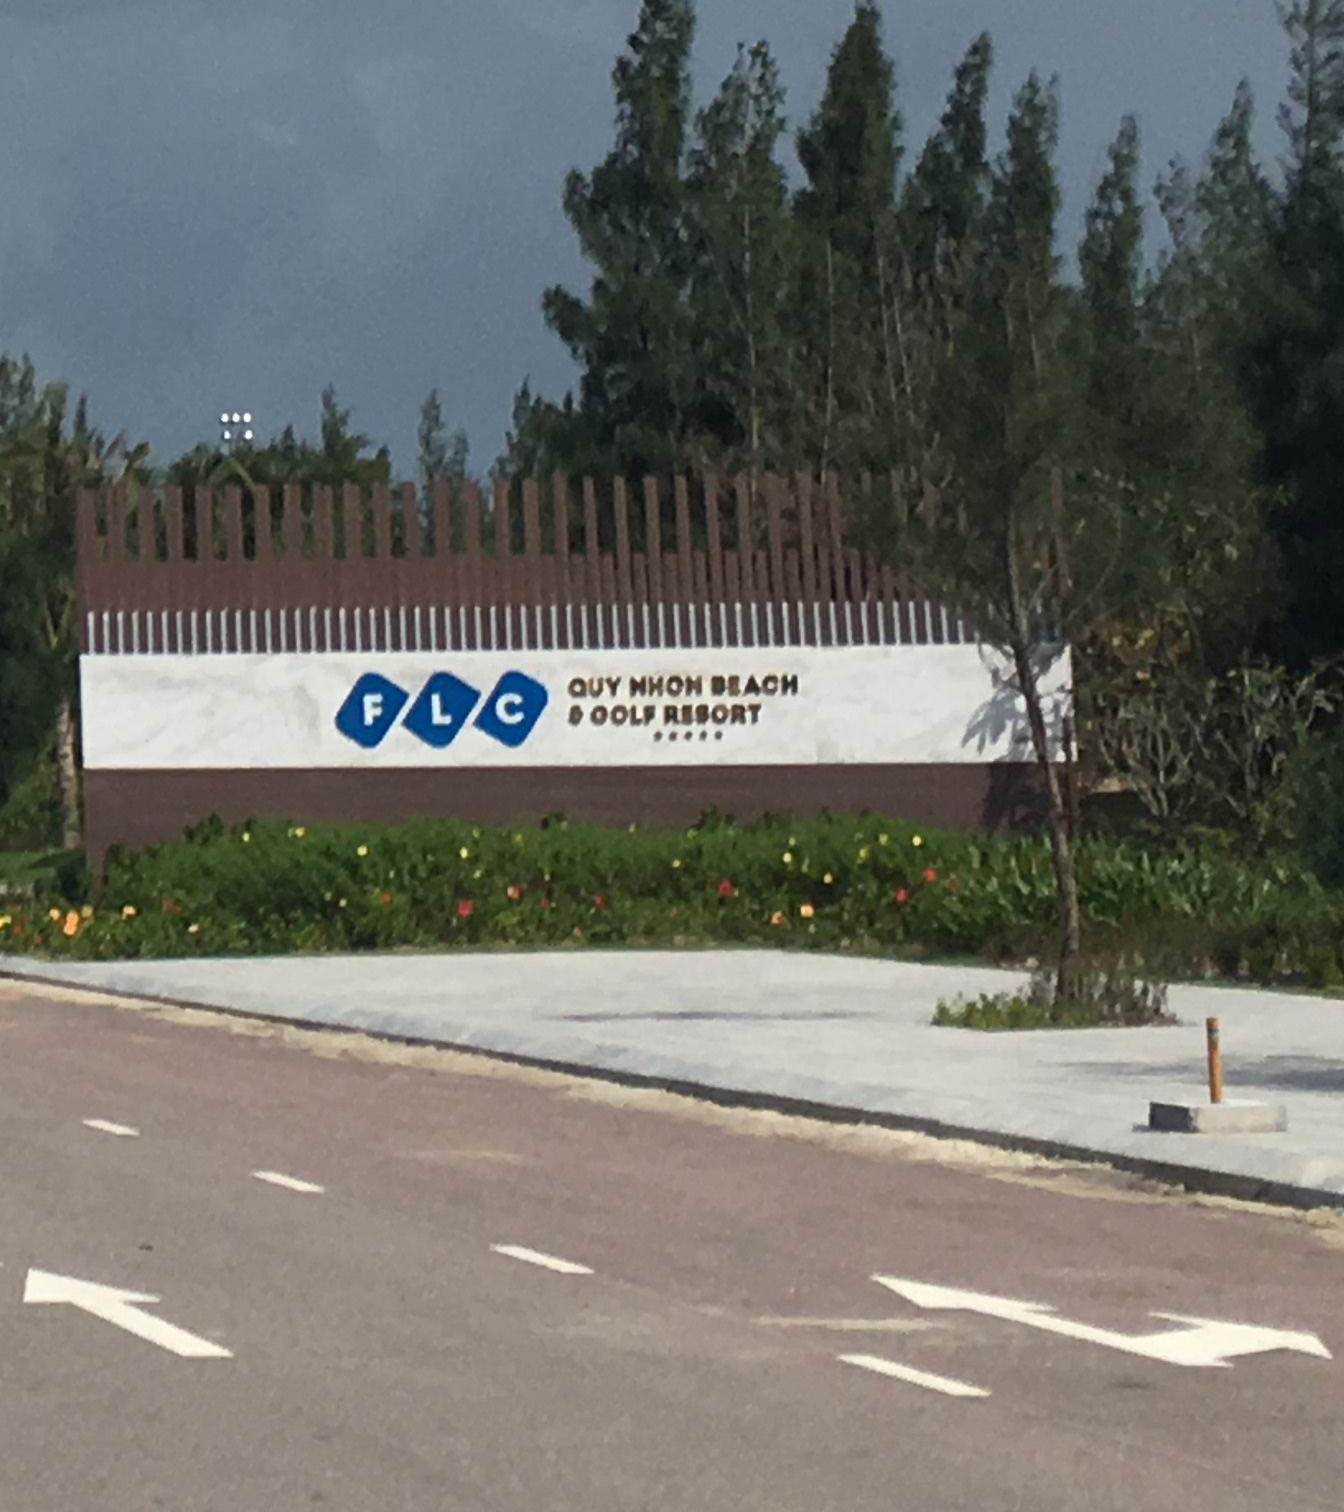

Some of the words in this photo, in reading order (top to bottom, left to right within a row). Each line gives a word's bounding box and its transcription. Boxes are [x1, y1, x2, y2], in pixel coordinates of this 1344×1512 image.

[567, 676, 622, 698] QUY
[629, 674, 703, 698] NHON
[710, 674, 799, 697] BEACH
[589, 704, 656, 726] GOLF
[663, 703, 762, 726] RESORT
